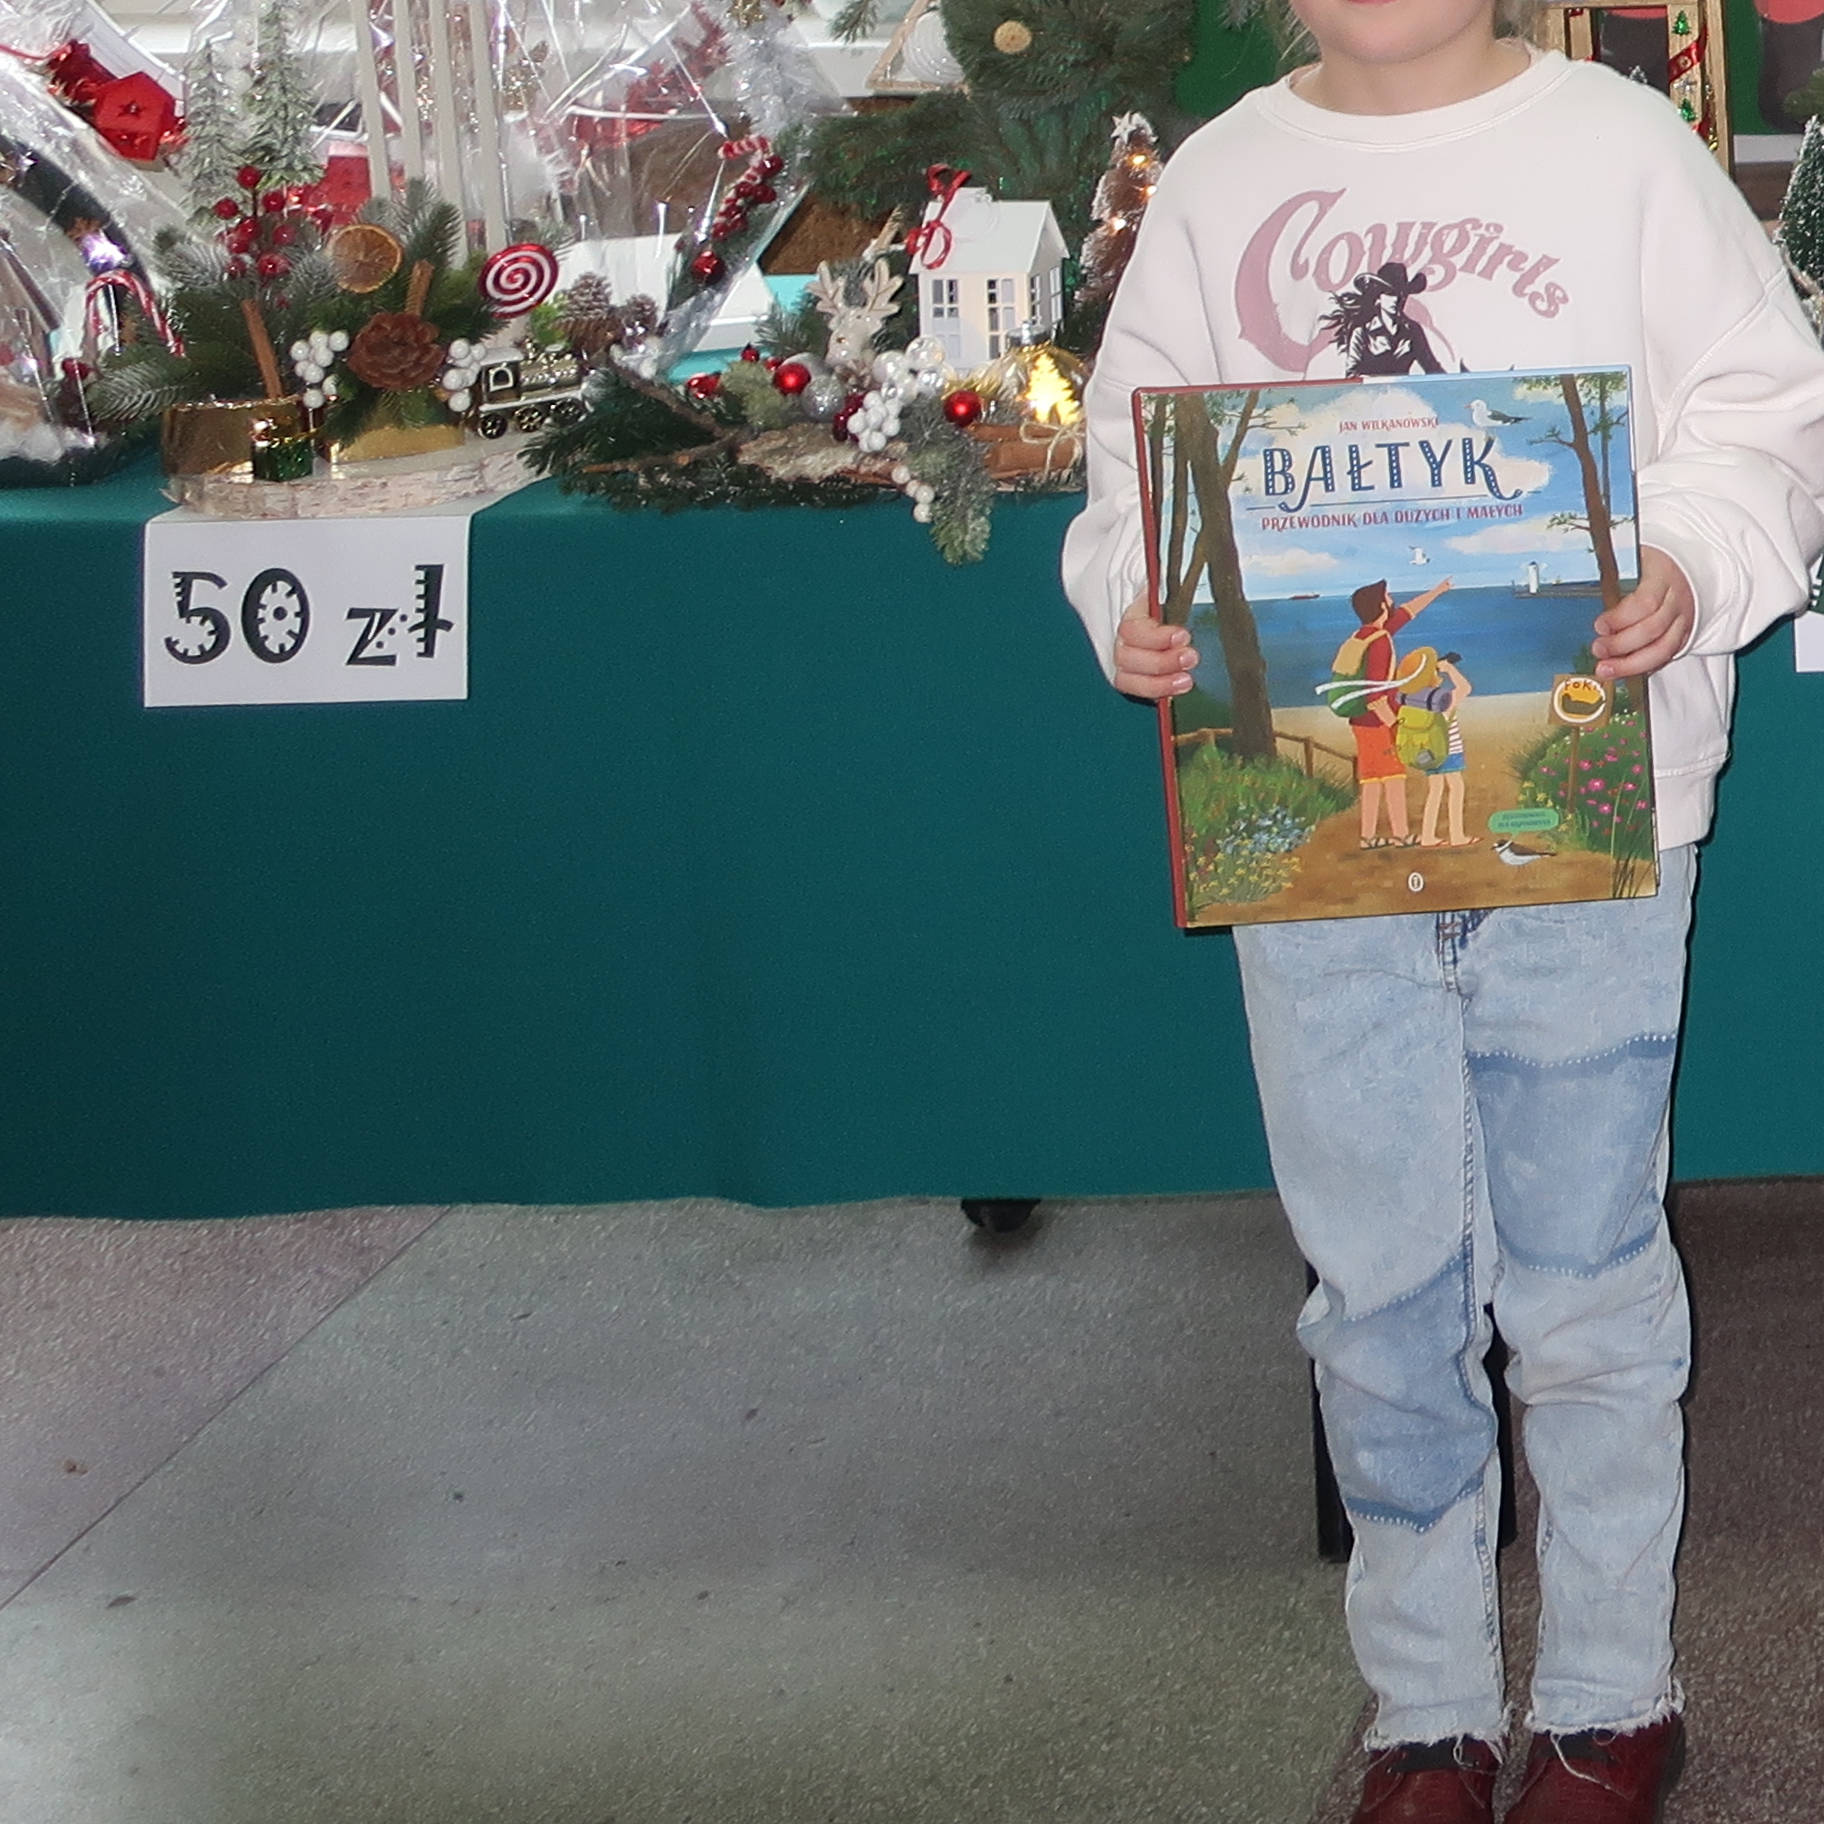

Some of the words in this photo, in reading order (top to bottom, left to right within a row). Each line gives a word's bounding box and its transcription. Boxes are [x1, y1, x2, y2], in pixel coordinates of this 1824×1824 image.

[1235, 187, 1570, 374] Cowgirls
[1338, 420, 1358, 434] JAN
[1361, 417, 1439, 432] WILKANOWSKI
[1263, 437, 1523, 513] BAŁTYK
[1261, 512, 1358, 531] PRZEWODNIK
[1362, 511, 1389, 526] DLA
[1466, 503, 1524, 520] MAŁYCH
[163, 567, 312, 666] 50
[344, 563, 455, 667] zł
